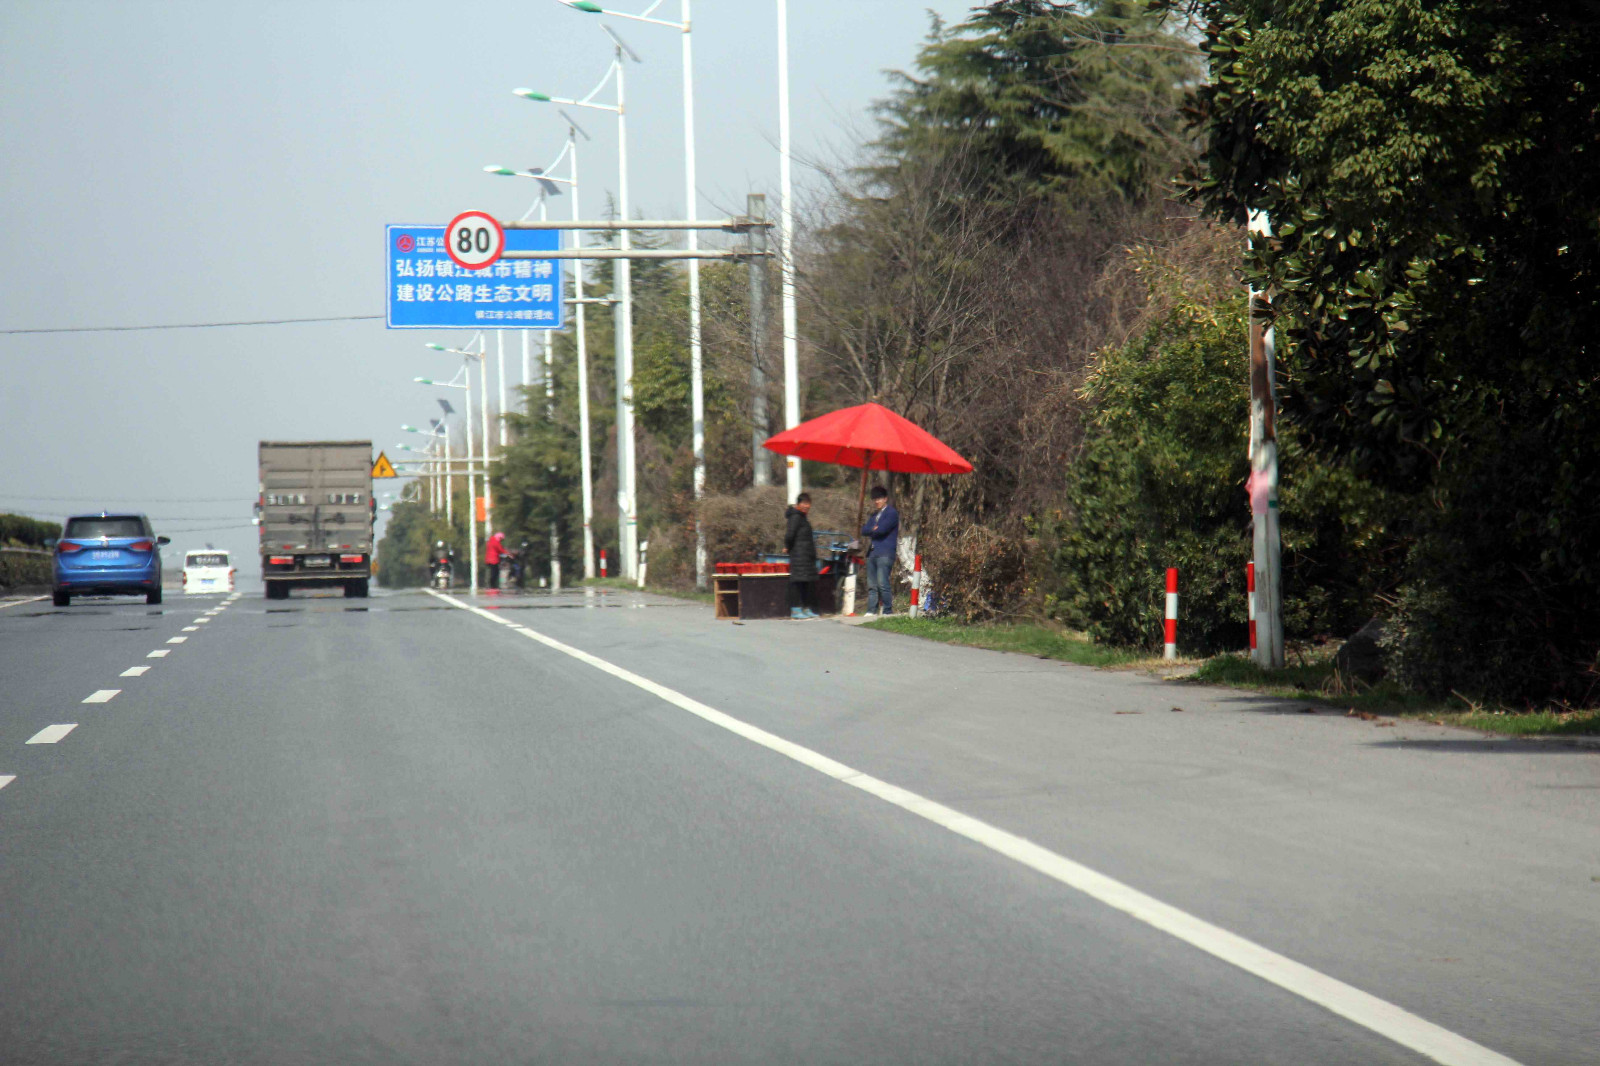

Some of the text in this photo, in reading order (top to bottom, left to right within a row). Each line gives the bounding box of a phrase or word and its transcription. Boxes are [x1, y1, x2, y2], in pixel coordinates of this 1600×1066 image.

[457, 227, 490, 253] 80
[396, 284, 553, 303] 建设公路生态文明
